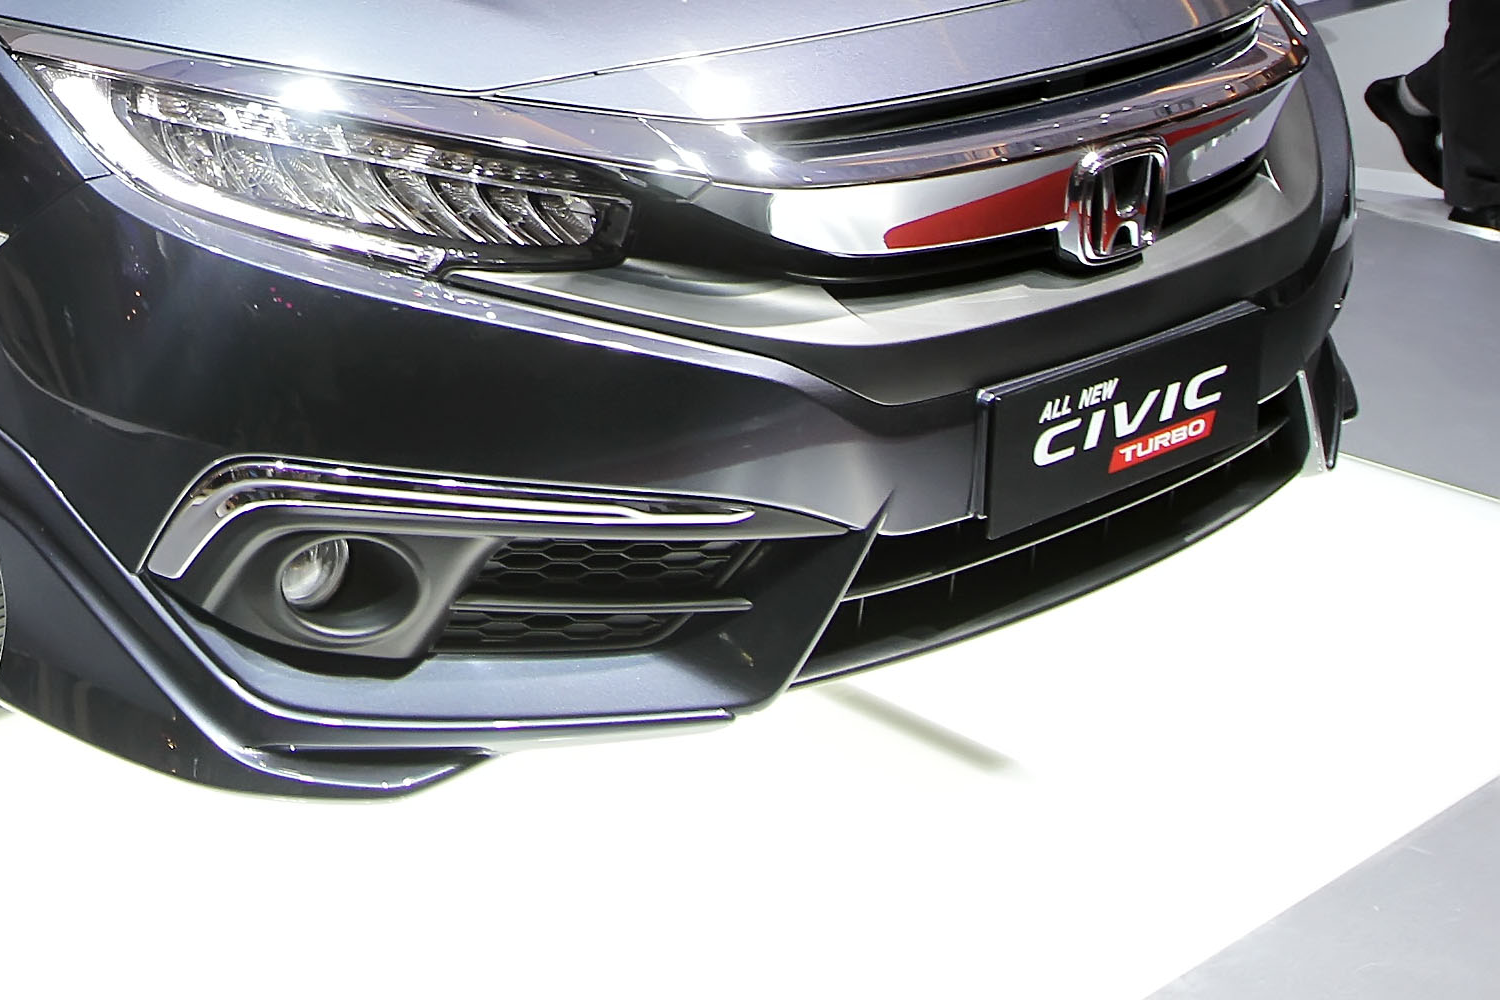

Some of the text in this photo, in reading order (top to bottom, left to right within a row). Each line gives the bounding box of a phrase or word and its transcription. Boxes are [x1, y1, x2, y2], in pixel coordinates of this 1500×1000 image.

[1033, 364, 1228, 467] CIVIC
[1038, 377, 1119, 424] ALL NEW
[1119, 418, 1206, 463] TURBO
